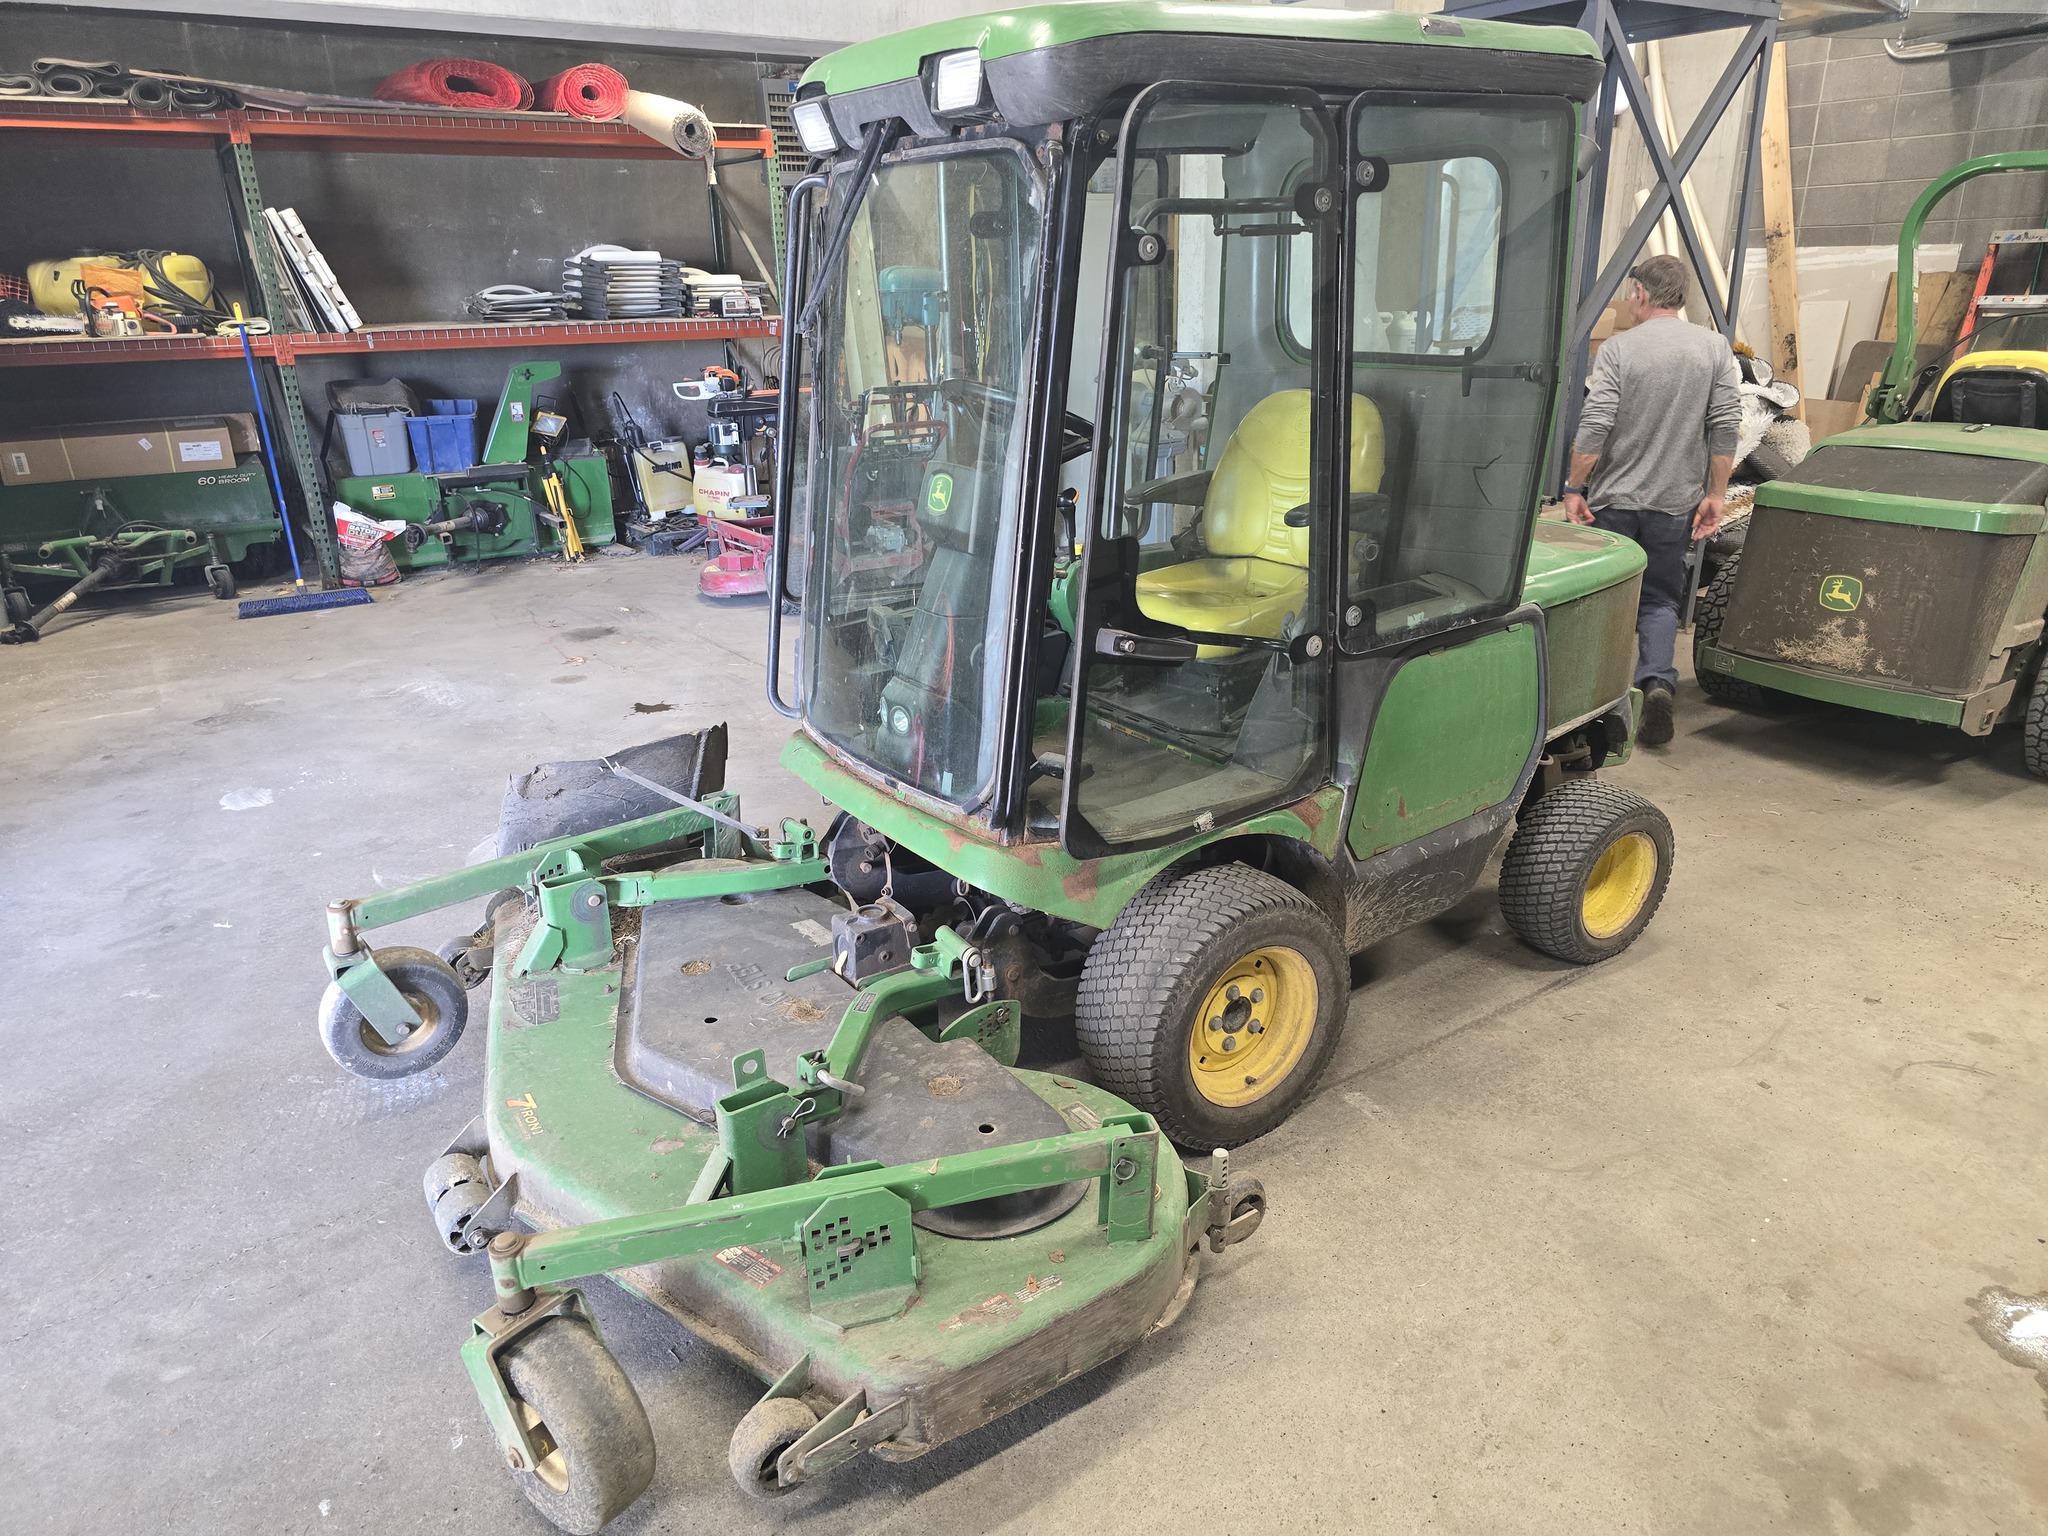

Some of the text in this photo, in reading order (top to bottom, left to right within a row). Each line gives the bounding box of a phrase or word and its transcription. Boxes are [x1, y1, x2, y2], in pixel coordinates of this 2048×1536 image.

[198, 476, 216, 486] 60
[218, 477, 250, 485] BROOM
[698, 488, 730, 497] CHAPIN
